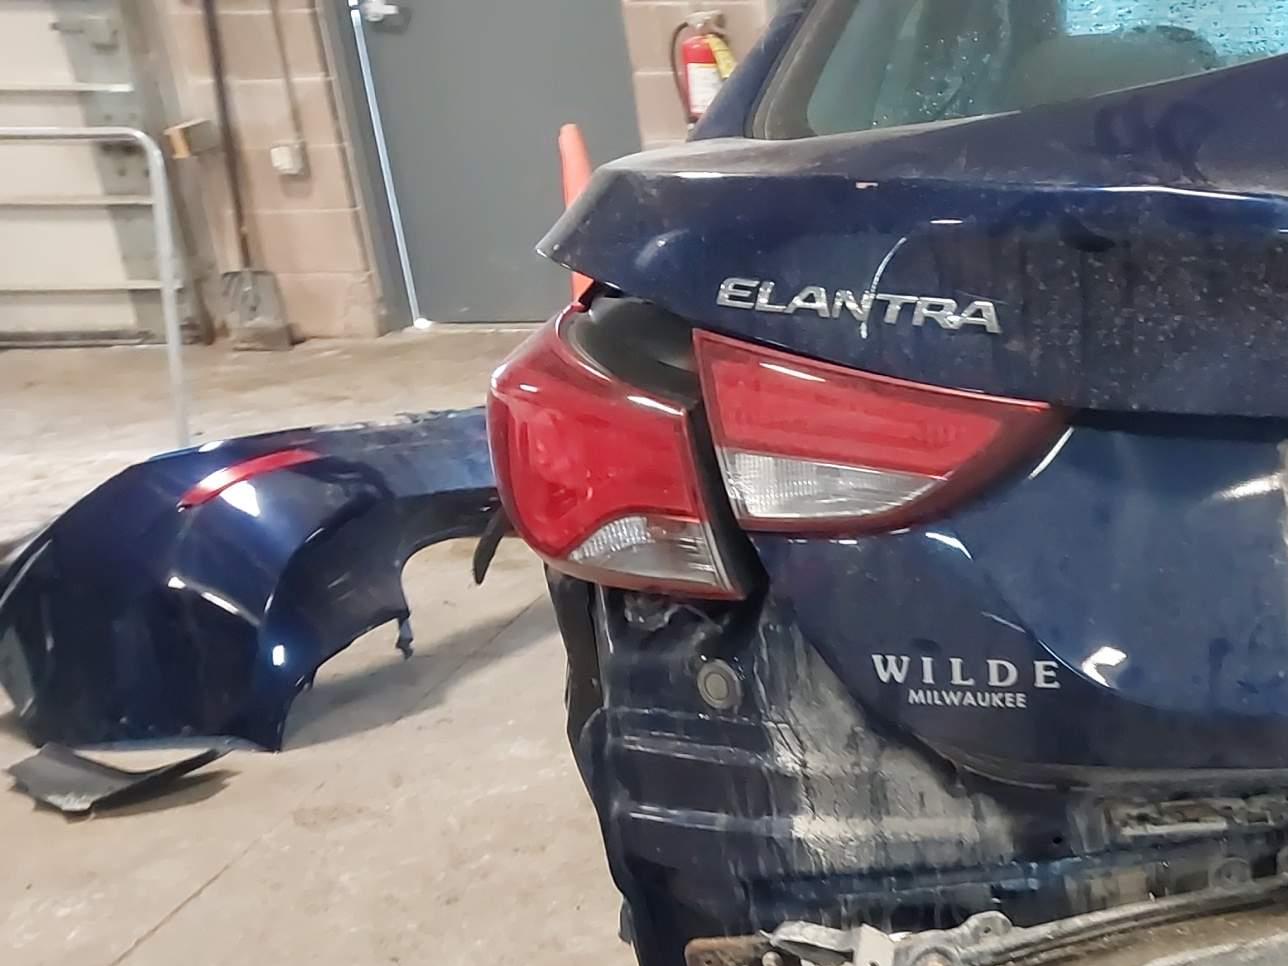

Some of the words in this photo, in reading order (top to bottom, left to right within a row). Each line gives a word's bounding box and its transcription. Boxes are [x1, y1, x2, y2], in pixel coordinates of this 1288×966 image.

[716, 276, 1002, 334] ELANTRA
[871, 653, 1061, 689] WILDE
[908, 688, 1028, 708] MILWAUKEE
